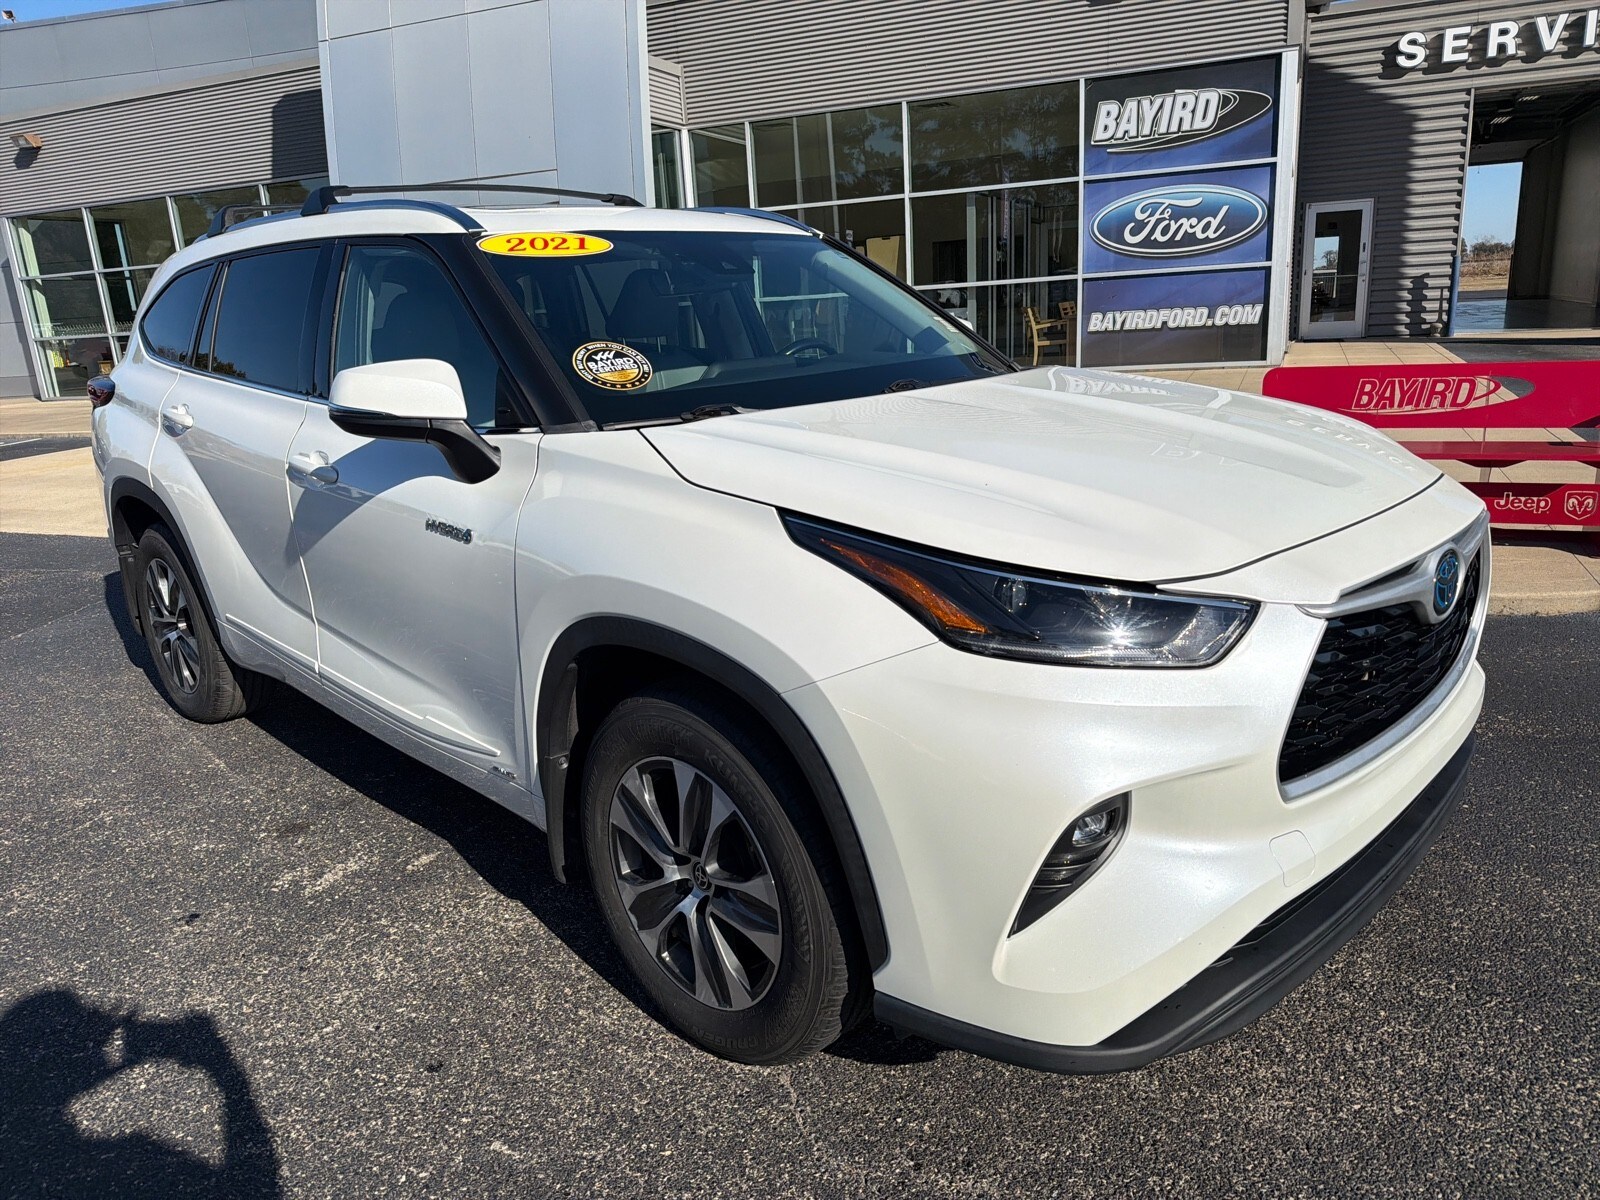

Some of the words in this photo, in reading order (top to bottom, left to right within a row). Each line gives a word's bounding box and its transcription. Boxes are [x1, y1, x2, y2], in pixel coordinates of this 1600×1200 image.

[1396, 9, 1599, 68] SERVI
[1092, 88, 1222, 145] BAYIRD
[1123, 196, 1230, 244] Ford
[505, 237, 591, 252] 2021
[1087, 303, 1264, 333] BAYIRDFORD.COM
[587, 357, 634, 370] BAYIRD
[623, 347, 637, 357] CAN
[592, 364, 638, 374] CERTIFIED
[1351, 376, 1478, 410] BAYIRD
[1494, 492, 1551, 514] Jeep
